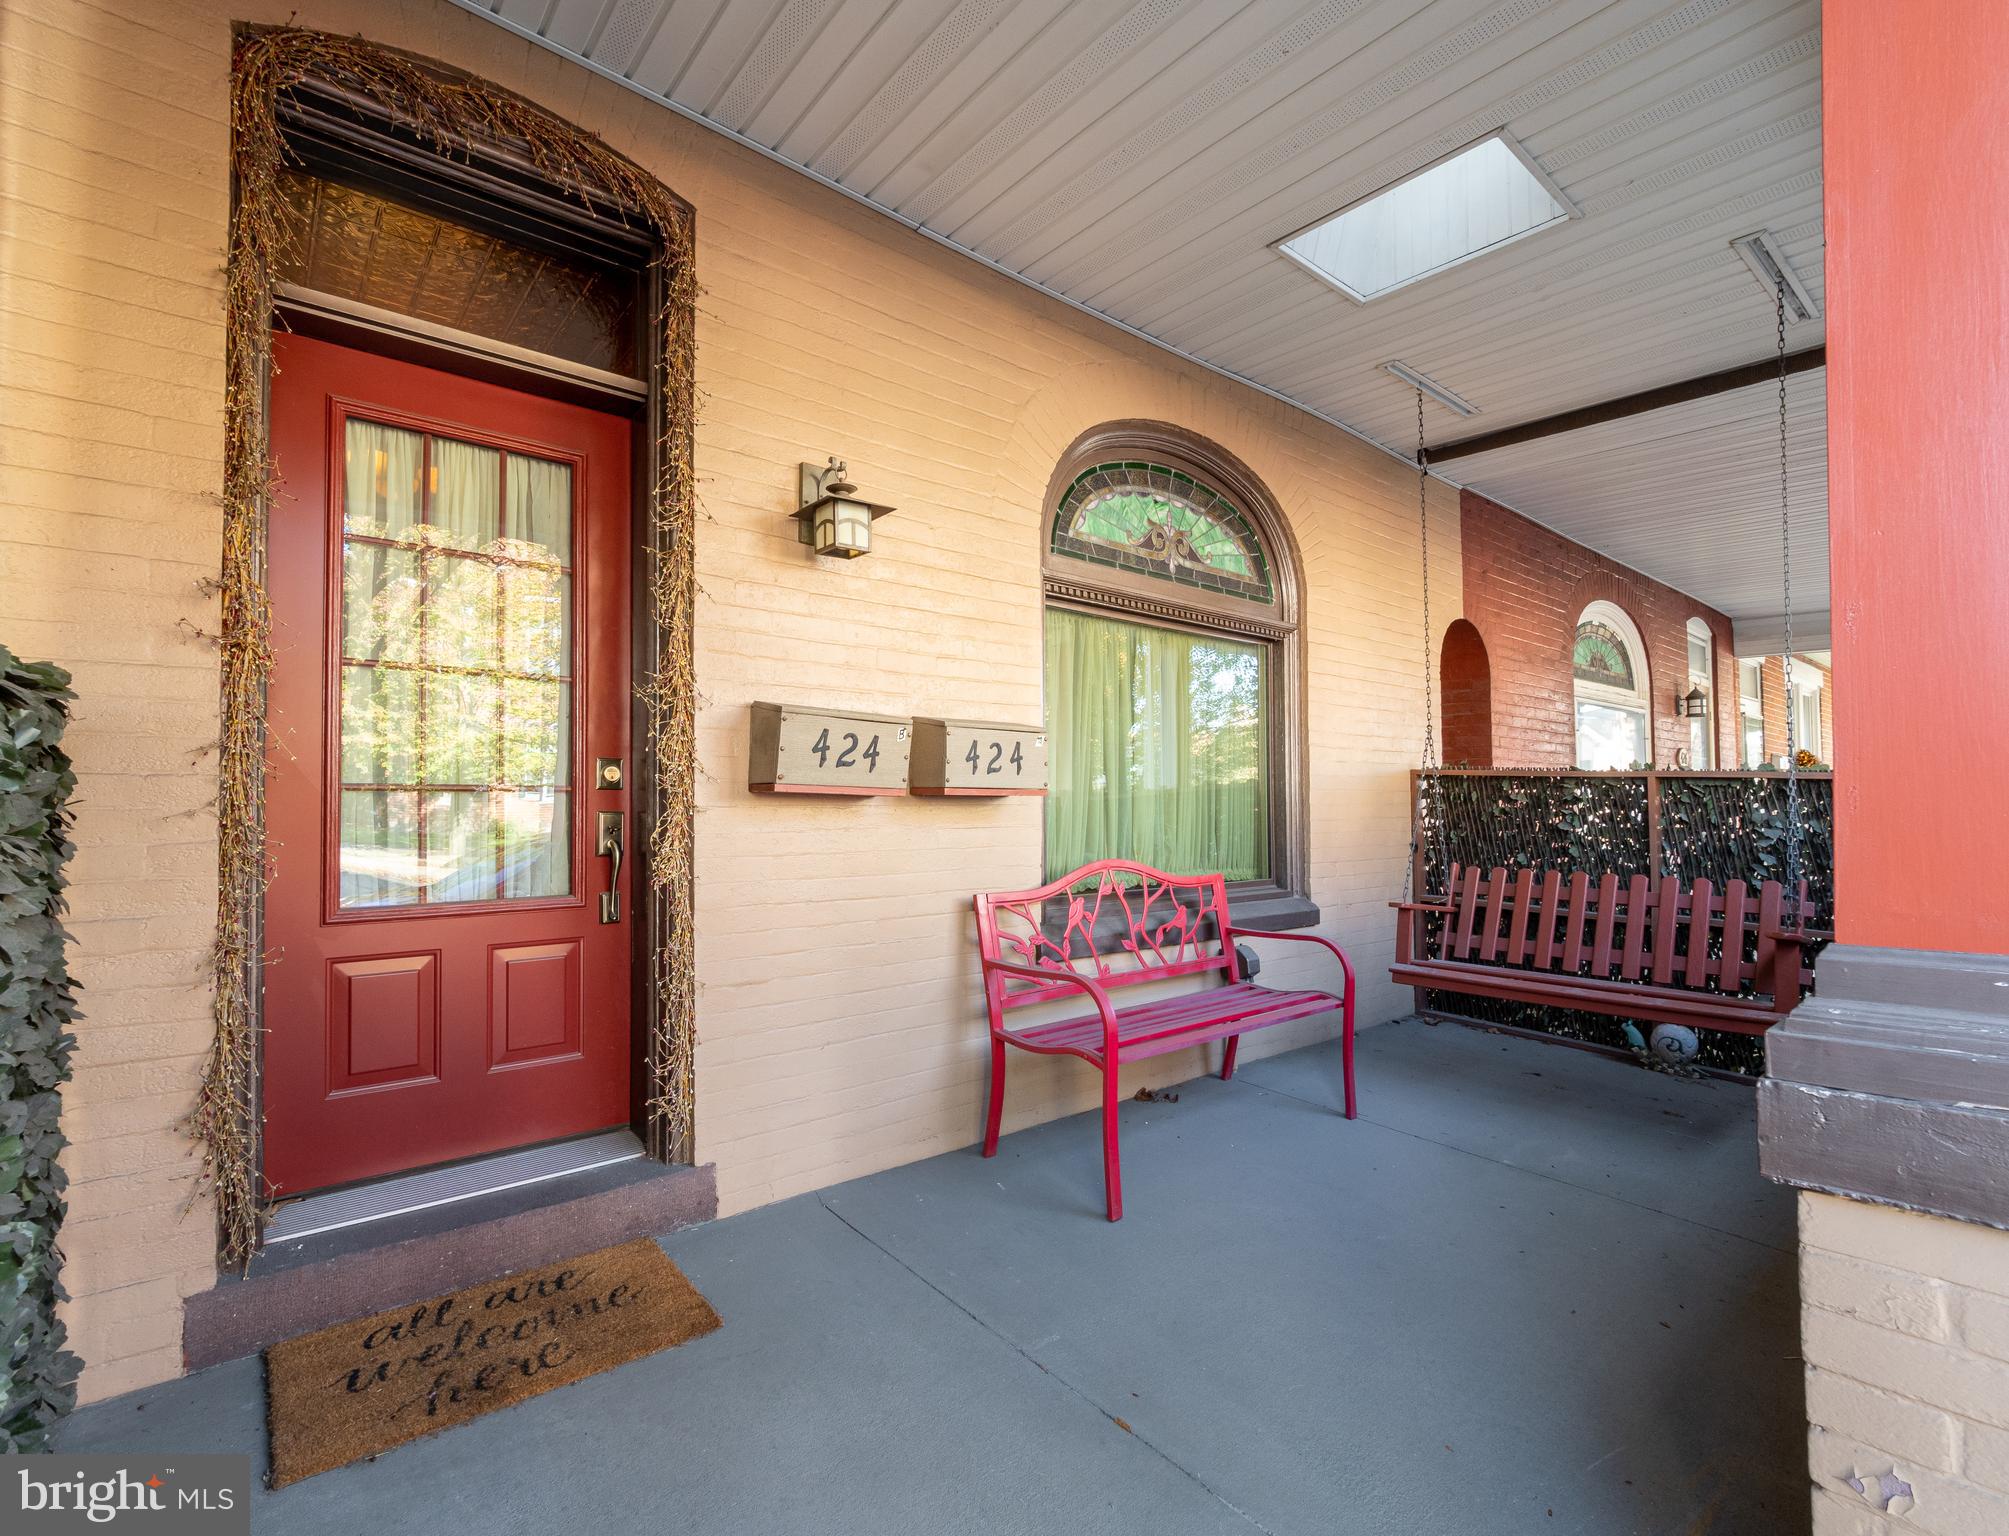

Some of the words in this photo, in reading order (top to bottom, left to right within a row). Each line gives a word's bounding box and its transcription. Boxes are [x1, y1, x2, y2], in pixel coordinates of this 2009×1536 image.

[811, 728, 880, 773] 424
[965, 739, 1024, 776] 424
[328, 1283, 647, 1393] welcome
[363, 1299, 454, 1350] all
[485, 1270, 594, 1311] are
[390, 1342, 577, 1416] here
